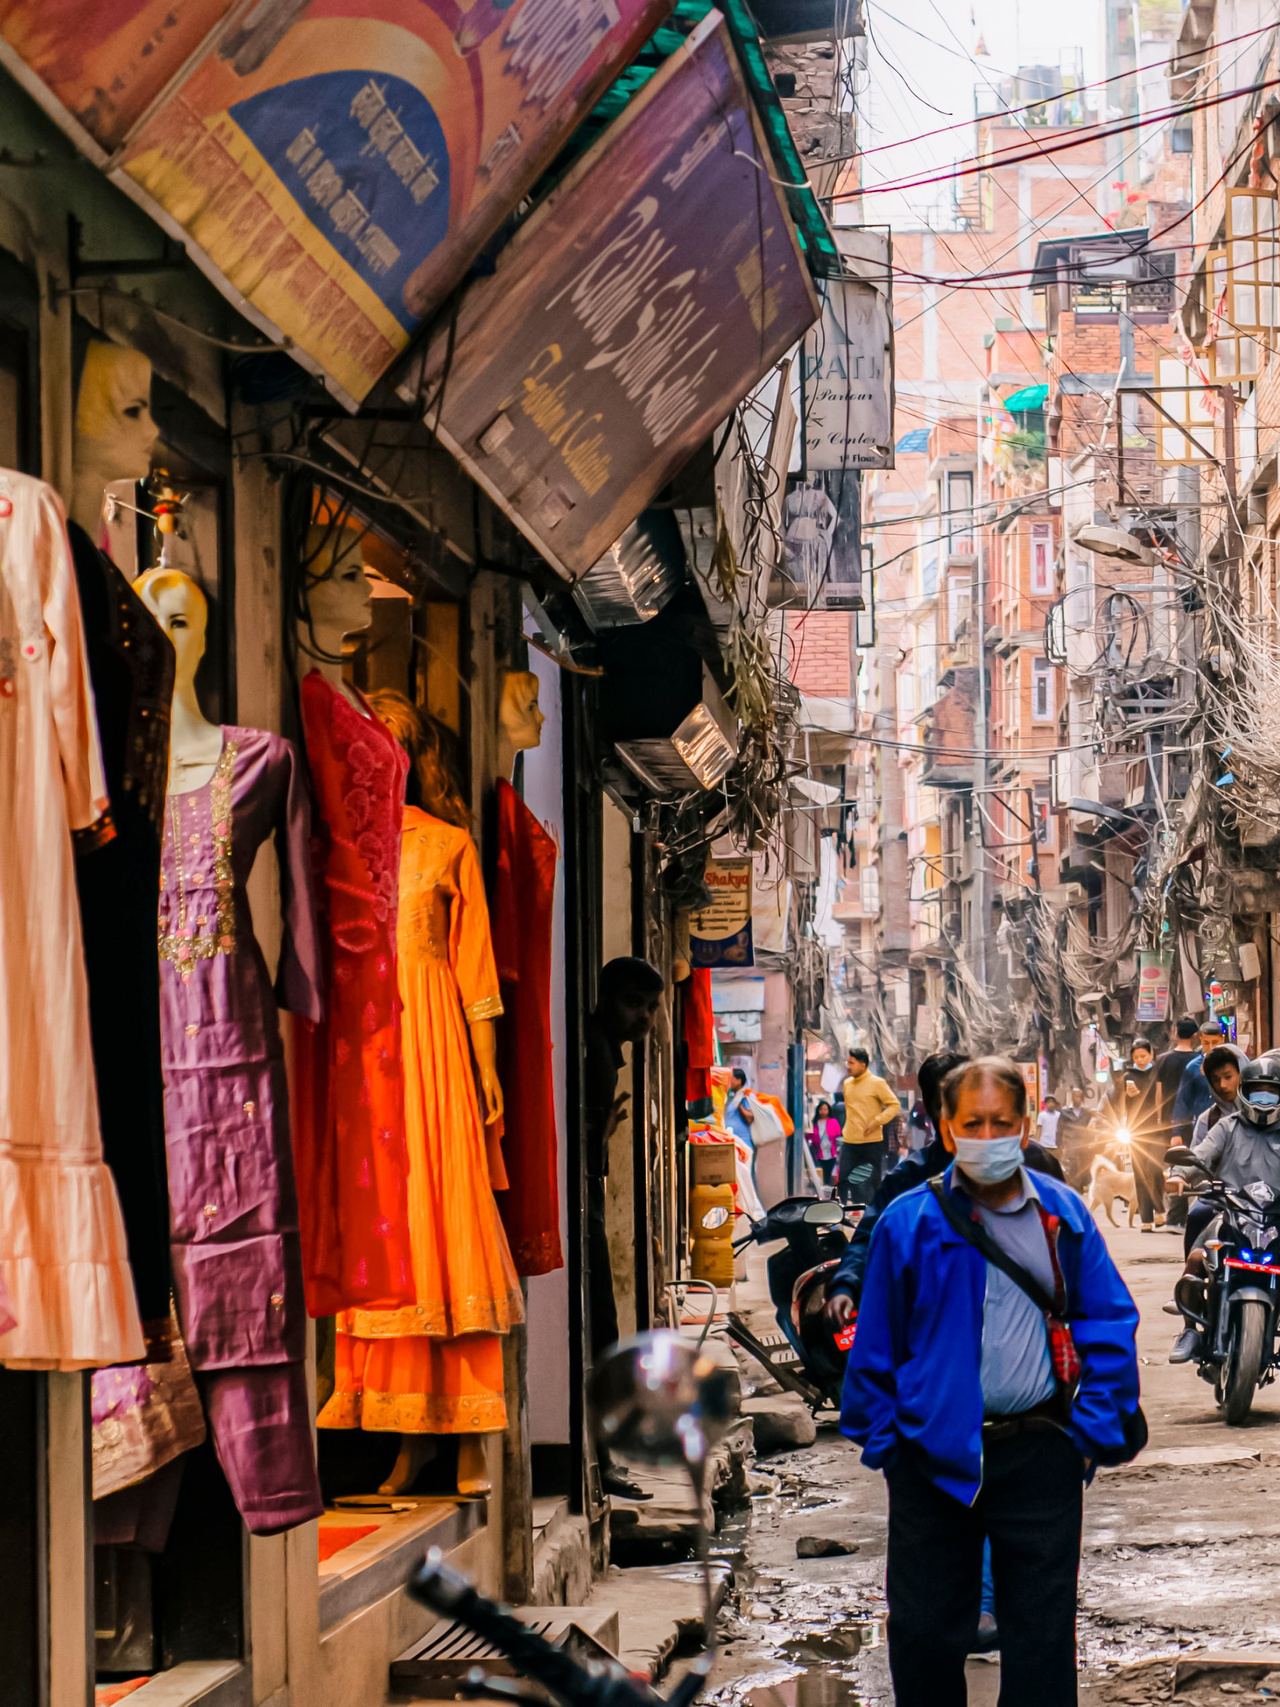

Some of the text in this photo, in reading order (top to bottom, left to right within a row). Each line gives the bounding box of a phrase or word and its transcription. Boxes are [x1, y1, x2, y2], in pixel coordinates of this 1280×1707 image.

[545, 195, 677, 345] Riddhi
[583, 268, 705, 399] Siddhi
[497, 343, 574, 434] Fashion
[560, 412, 612, 498] Collection
[638, 323, 720, 447] Ladies
[816, 388, 873, 402] Parlour
[827, 432, 877, 445] Center
